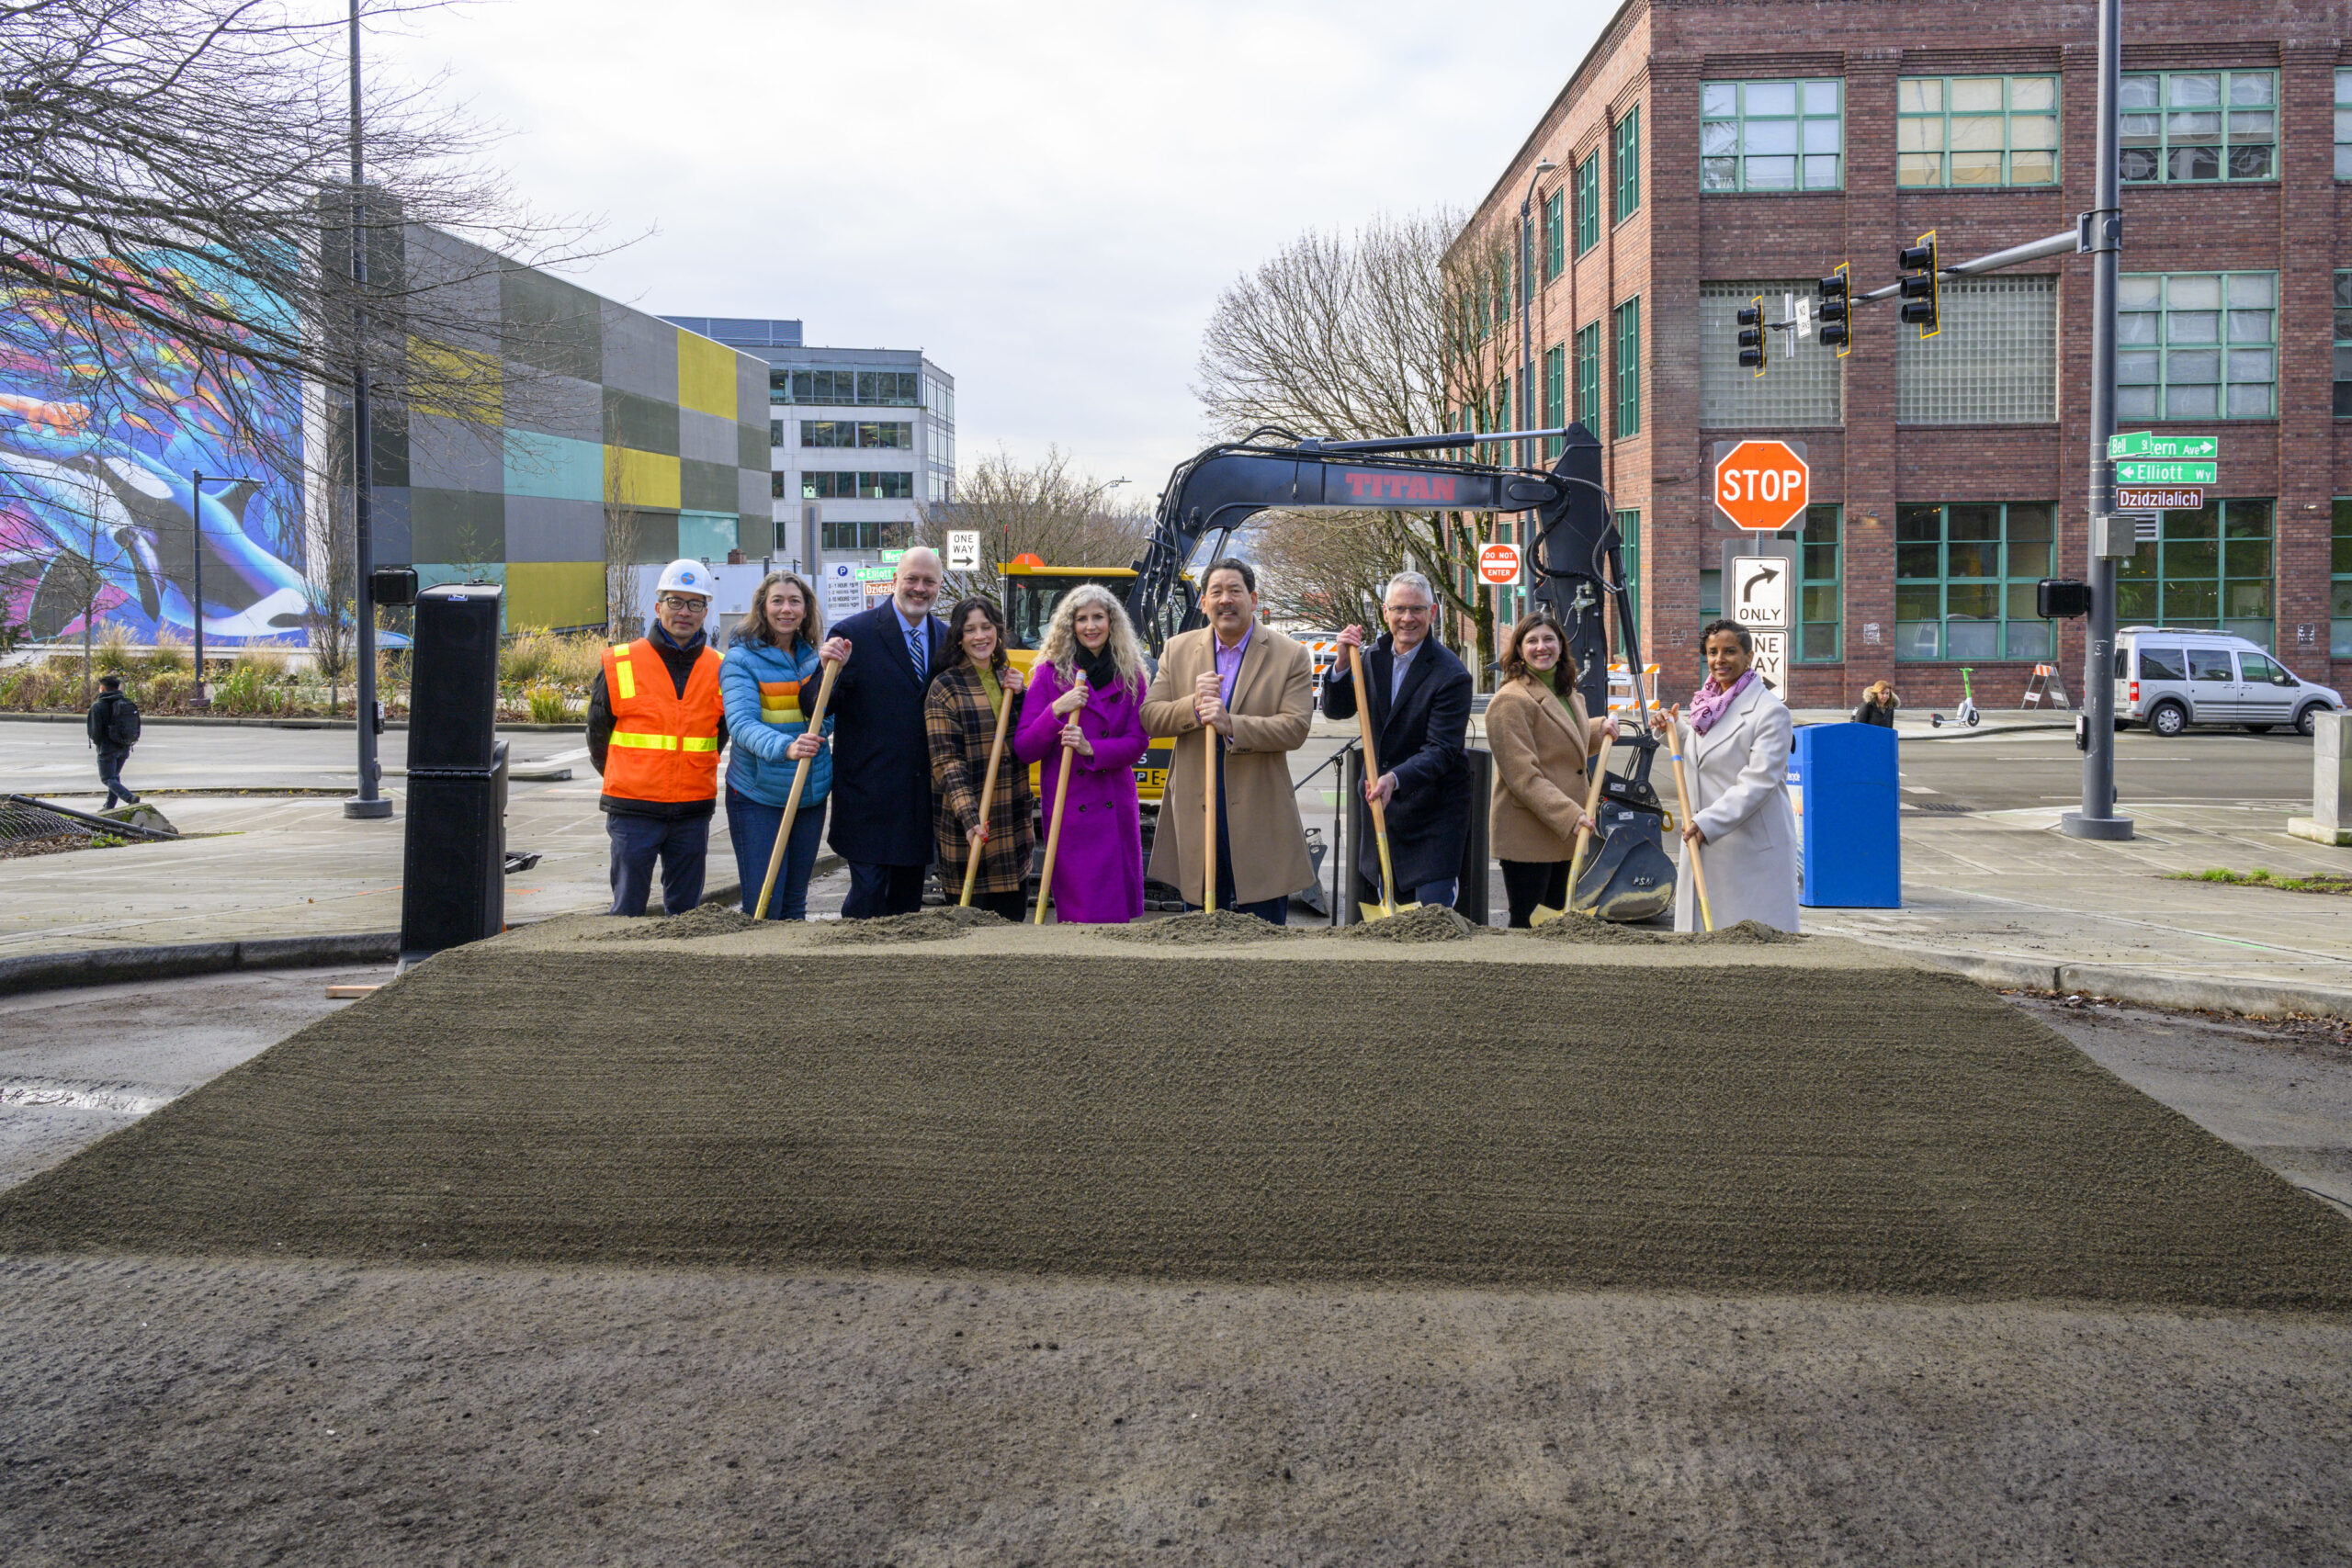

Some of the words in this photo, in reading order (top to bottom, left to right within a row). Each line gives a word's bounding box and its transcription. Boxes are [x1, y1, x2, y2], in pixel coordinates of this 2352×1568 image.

[2112, 438, 2127, 454] Bell
[2141, 439, 2148, 450] St
[2183, 445, 2200, 456] Ave
[2137, 464, 2184, 480] Elliott
[2195, 469, 2211, 482] Wy
[1345, 473, 1456, 501] TITAN
[1723, 468, 1802, 502] STOP
[2120, 491, 2199, 507] Dzidzilalich
[954, 534, 974, 544] ONE
[953, 545, 975, 554] WAY
[866, 570, 892, 579] Elliott
[1487, 569, 1510, 577] ENTER
[1739, 608, 1781, 621] ONLY
[1754, 637, 1779, 653] NE
[1754, 657, 1780, 672] AY
